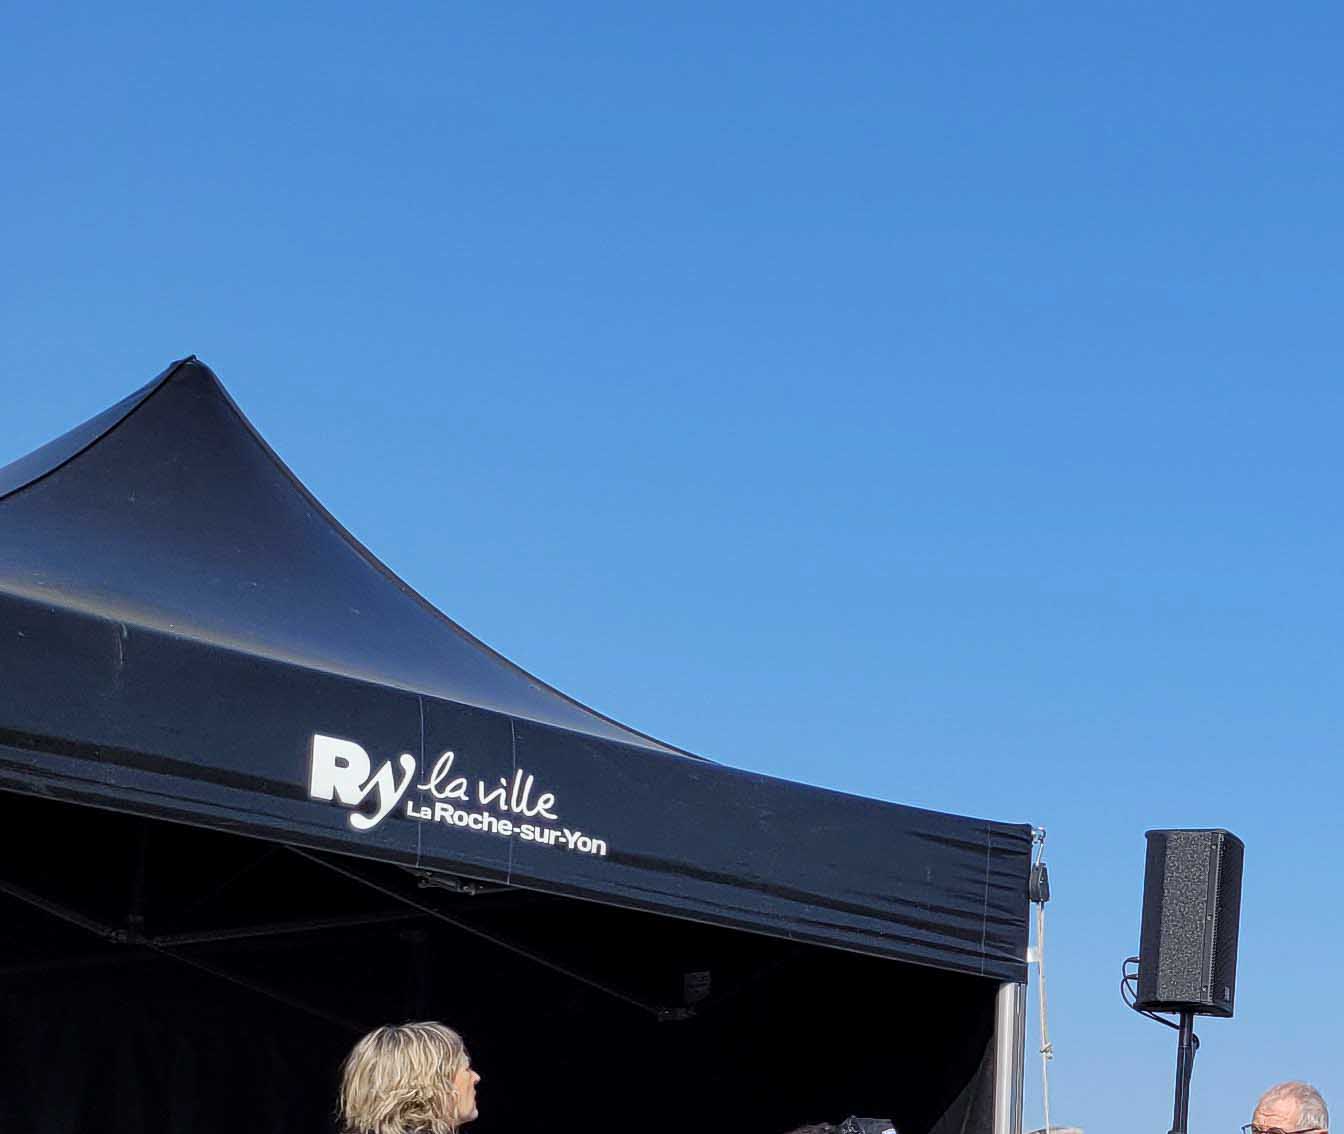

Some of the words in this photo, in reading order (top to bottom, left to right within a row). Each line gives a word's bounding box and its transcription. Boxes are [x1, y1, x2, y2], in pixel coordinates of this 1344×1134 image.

[417, 751, 469, 801] la
[479, 769, 558, 820] ville
[406, 800, 432, 820] La
[434, 802, 607, 856] Roche-sur-Yon
